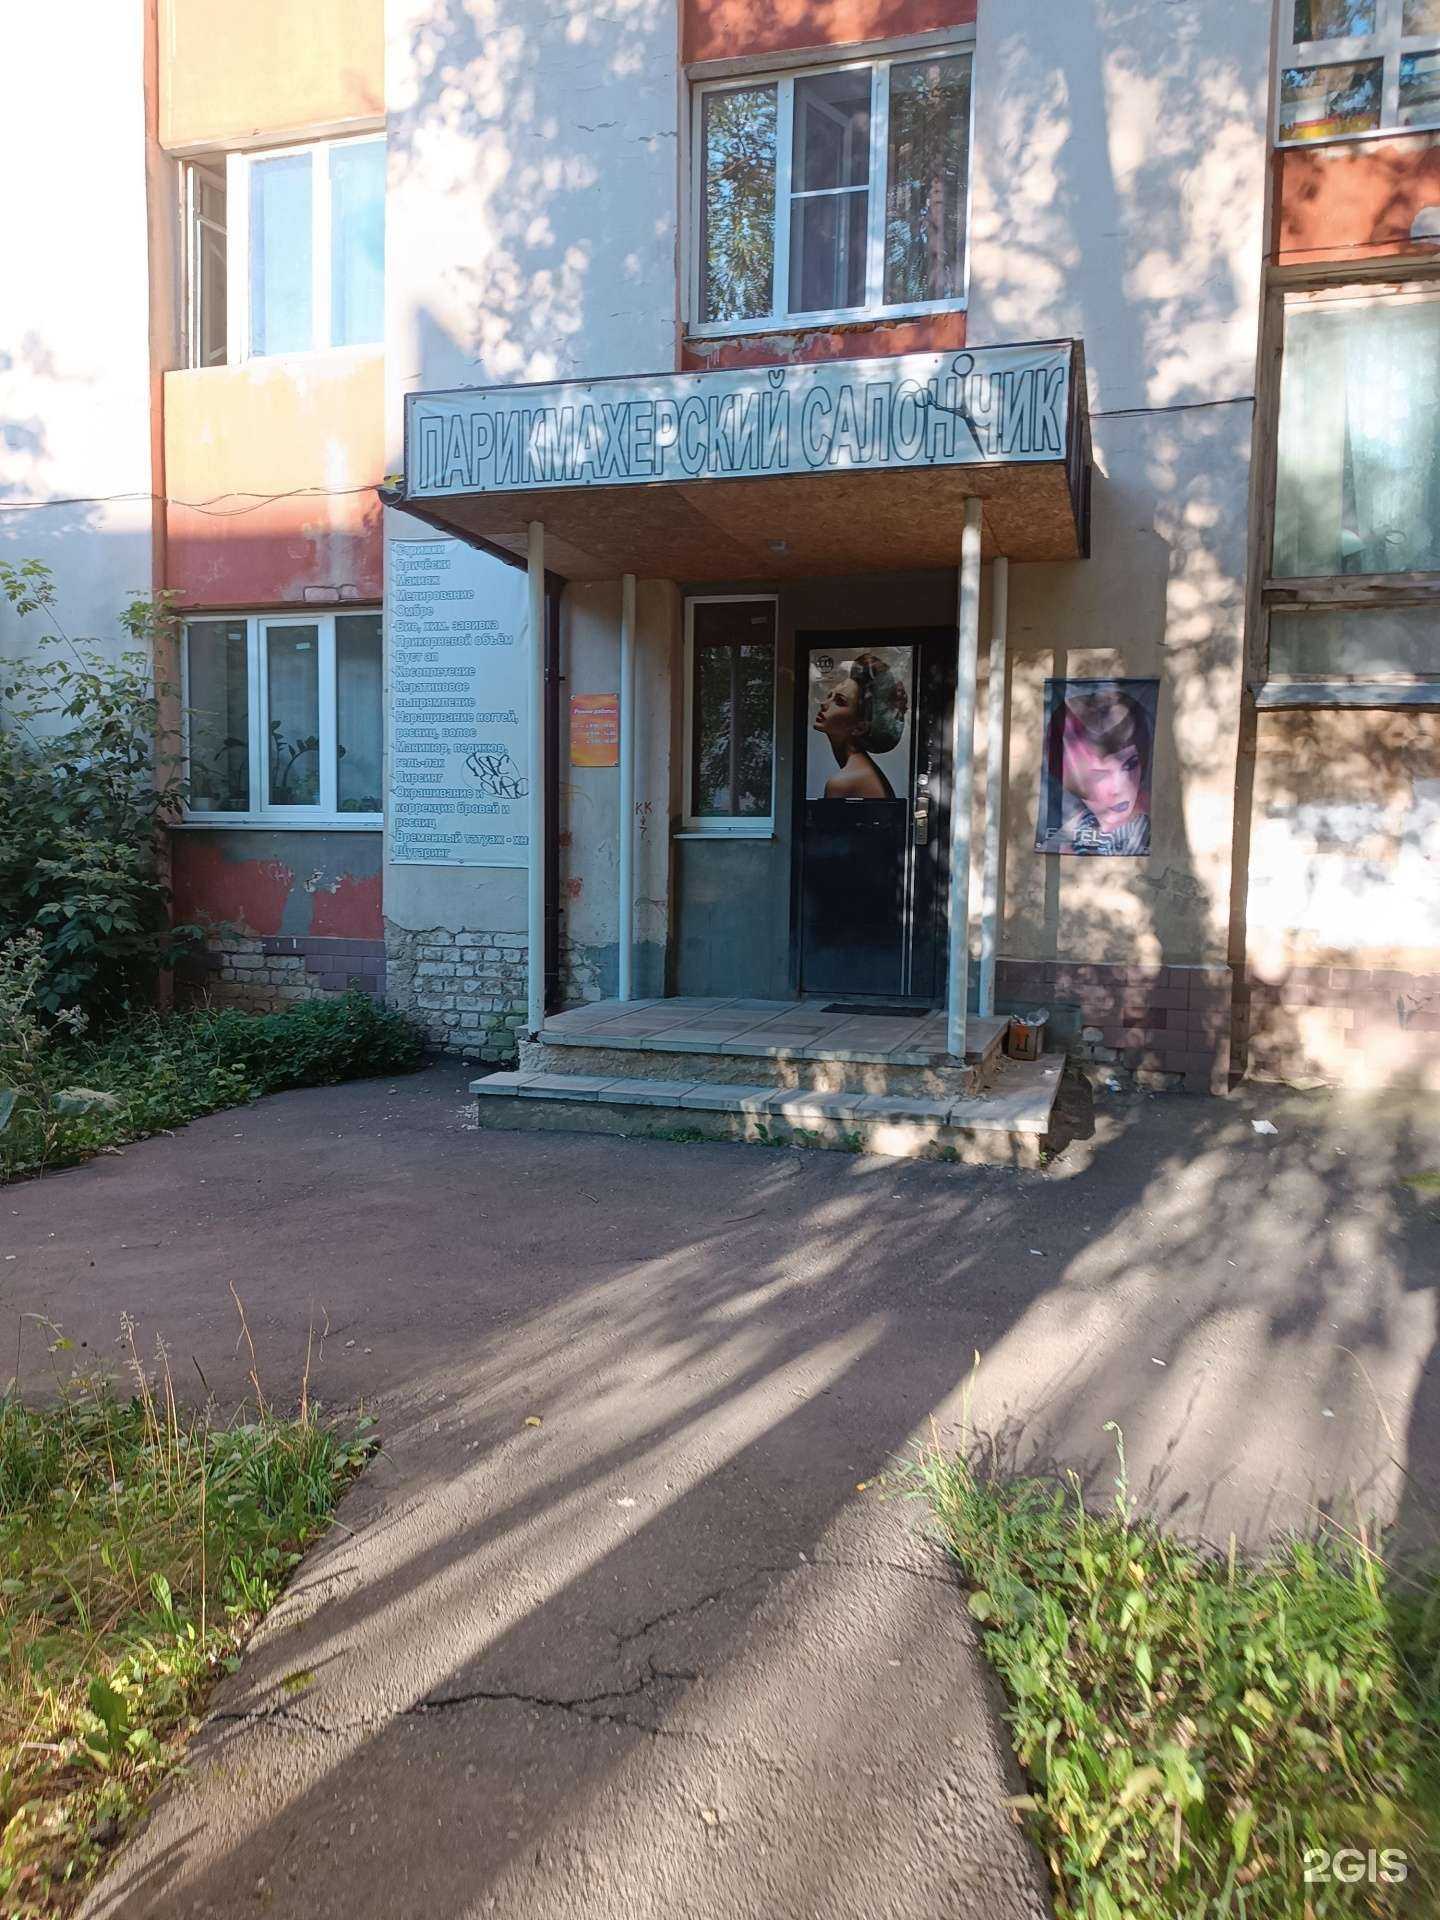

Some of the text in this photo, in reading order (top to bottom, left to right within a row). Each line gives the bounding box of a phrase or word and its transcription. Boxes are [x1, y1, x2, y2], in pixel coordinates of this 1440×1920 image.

[418, 366, 1064, 489] ПАРИКМАХЕРСКИЙ САЛОНЧИК
[396, 558, 451, 573] Причёски
[396, 589, 474, 603] Мелирование
[396, 604, 434, 618] Омбре
[452, 620, 498, 631] завивка
[396, 632, 513, 649] Прикорневой объём
[396, 665, 476, 678] Косоплетение
[396, 681, 470, 695] Кератиновое
[396, 697, 476, 710] выпрямление
[396, 710, 473, 725] Наращивание
[441, 728, 477, 738] волос
[396, 786, 473, 800] Окрашивание
[395, 801, 511, 816] коррекция бровей и
[395, 818, 437, 830] ресниц
[395, 828, 461, 844] Временный
[1045, 827, 1100, 842] ETEL
